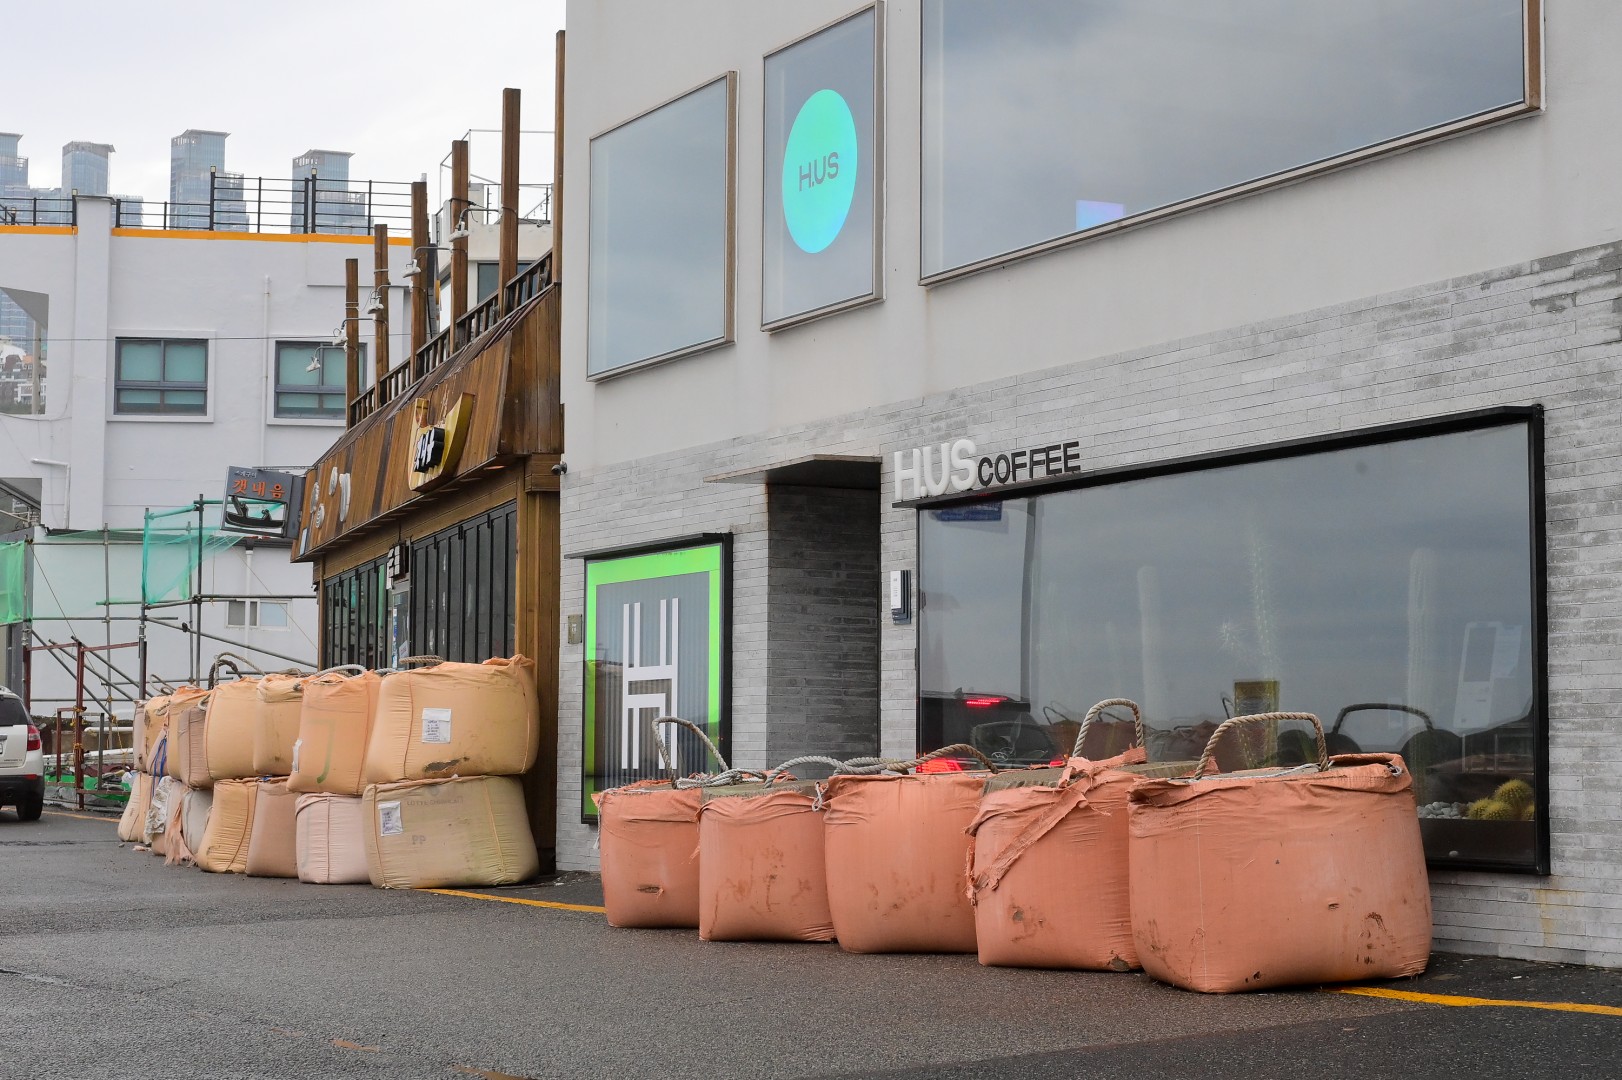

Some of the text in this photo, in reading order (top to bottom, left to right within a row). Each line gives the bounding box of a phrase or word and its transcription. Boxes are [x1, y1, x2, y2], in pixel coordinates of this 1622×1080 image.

[798, 151, 839, 192] H.US
[232, 479, 286, 500] 갯내음
[894, 438, 1081, 501] H.US COFFEE
